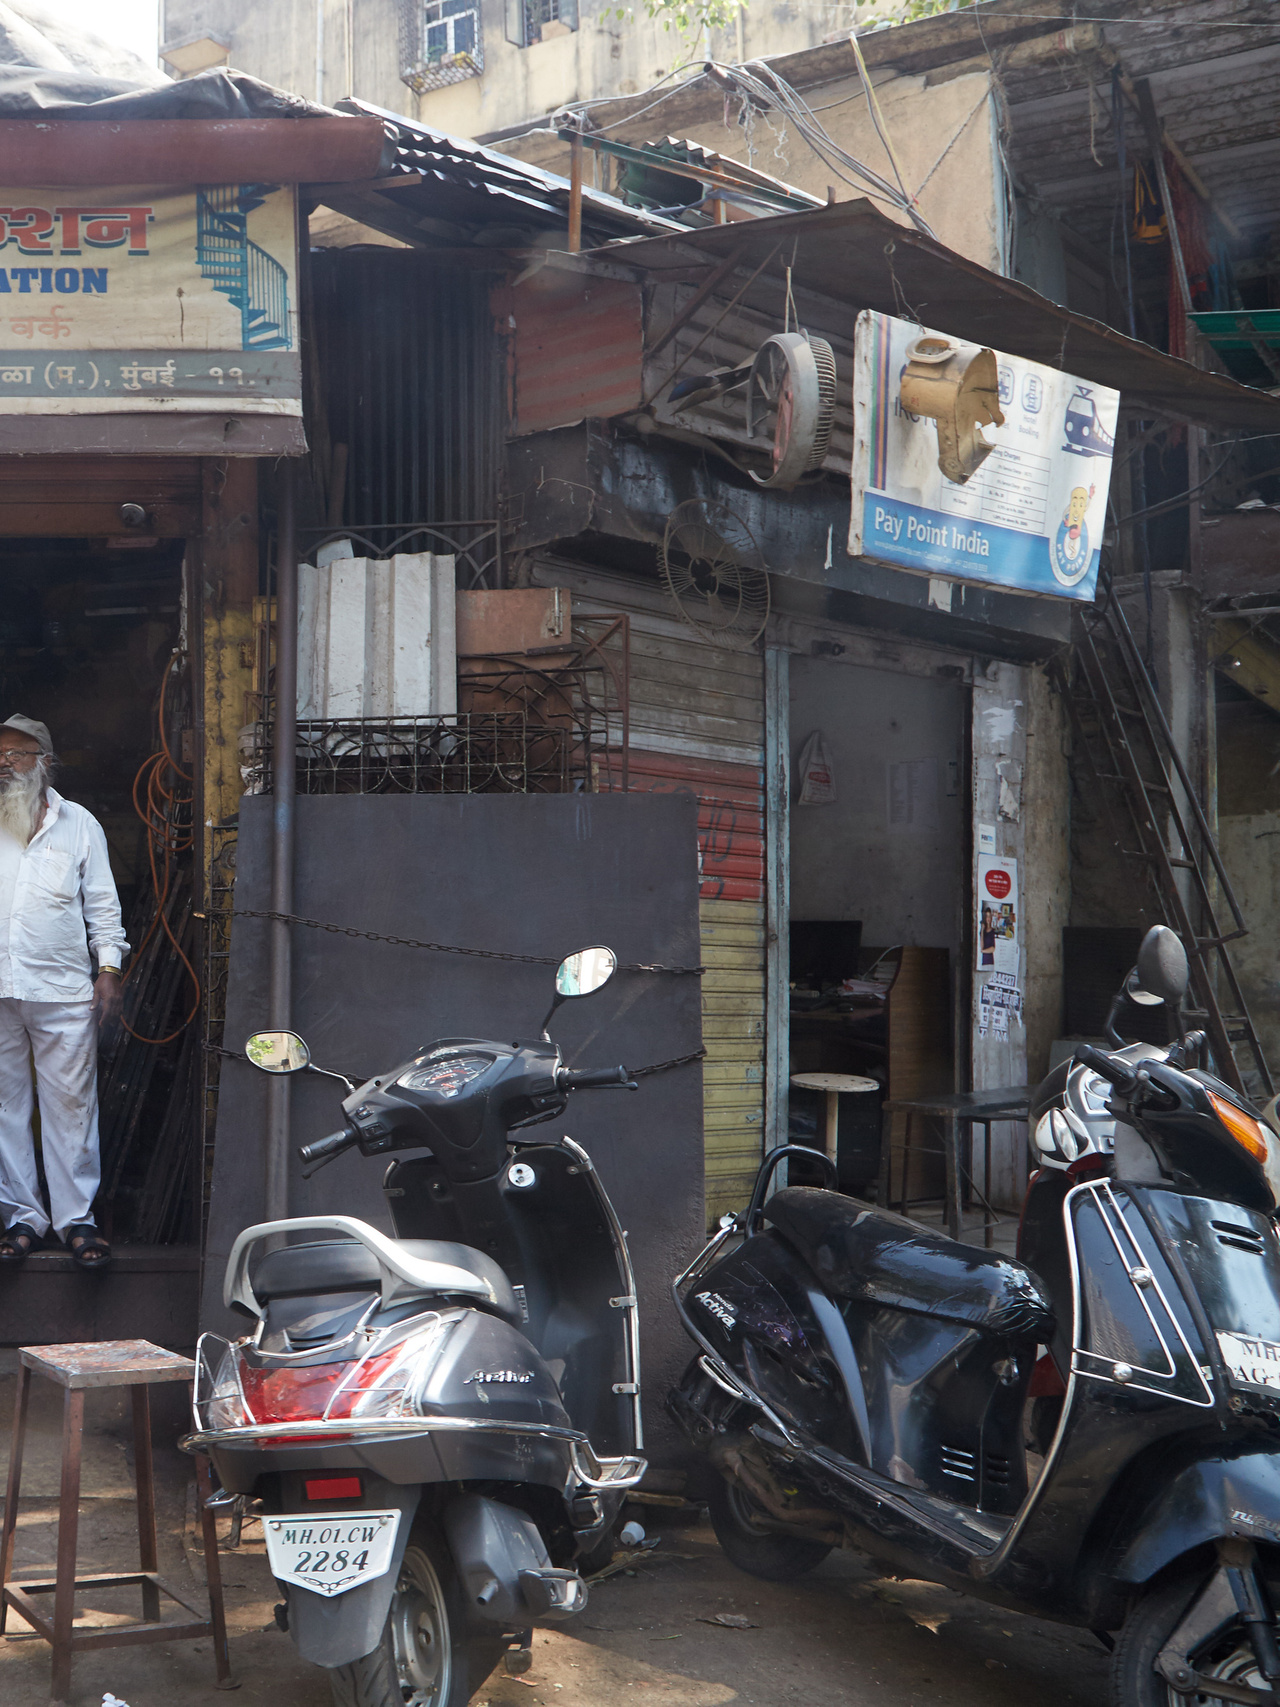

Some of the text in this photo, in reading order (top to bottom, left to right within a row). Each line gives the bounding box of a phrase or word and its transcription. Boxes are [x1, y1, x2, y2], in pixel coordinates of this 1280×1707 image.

[9, 305, 73, 340] वर्क
[120, 360, 176, 391] मुंबई
[875, 507, 903, 541] Pay
[907, 516, 948, 547] Point
[952, 527, 990, 557] India
[695, 1291, 736, 1328] Activa
[282, 1526, 382, 1545] MH.01.CW
[294, 1550, 369, 1572] 2284
